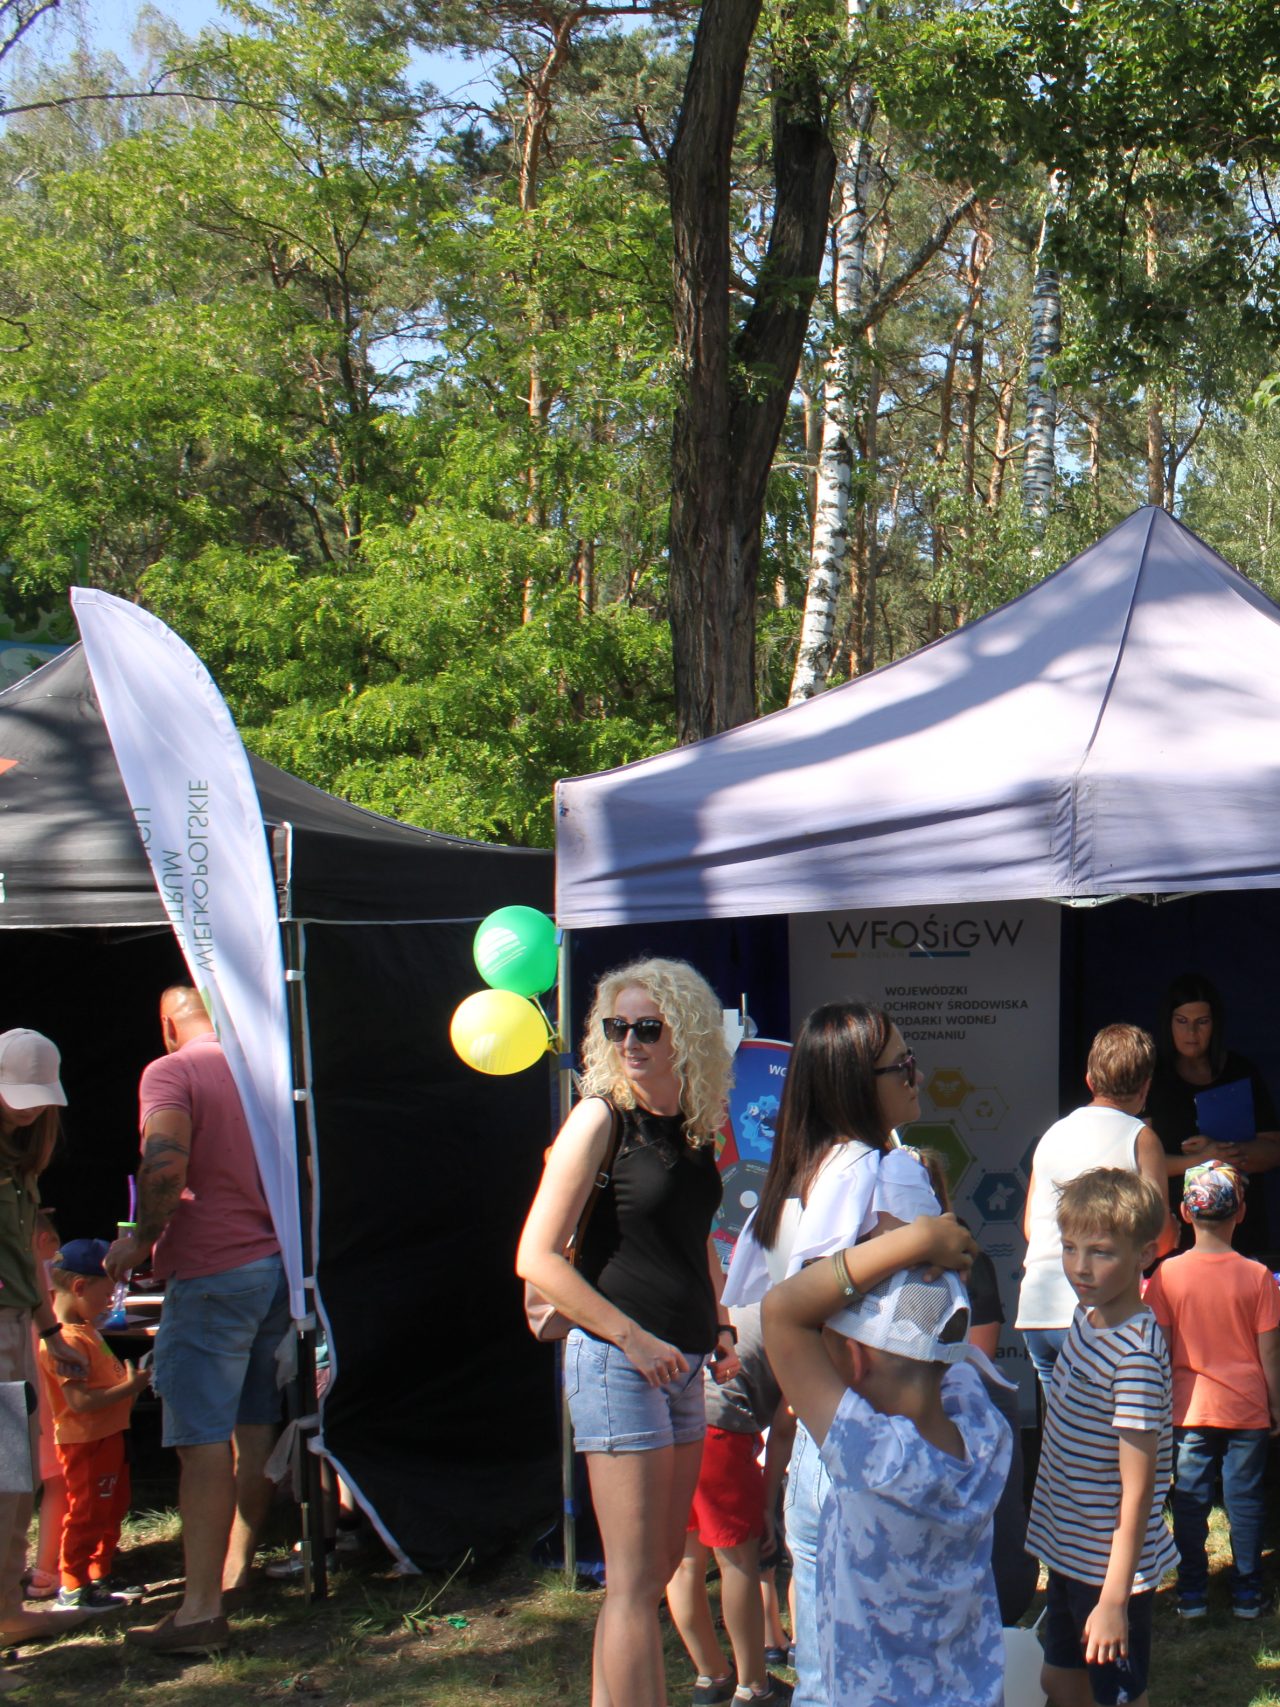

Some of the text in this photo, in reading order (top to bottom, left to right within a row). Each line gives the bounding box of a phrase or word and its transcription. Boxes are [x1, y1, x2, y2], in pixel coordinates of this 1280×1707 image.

[885, 984, 968, 997] WOJEWÓDZKI
[883, 998, 1028, 1012] OCHRONY ŚRODOWISKA
[889, 1015, 997, 1027] PODARKI WODNEJ
[903, 1030, 966, 1041] POZNANIU
